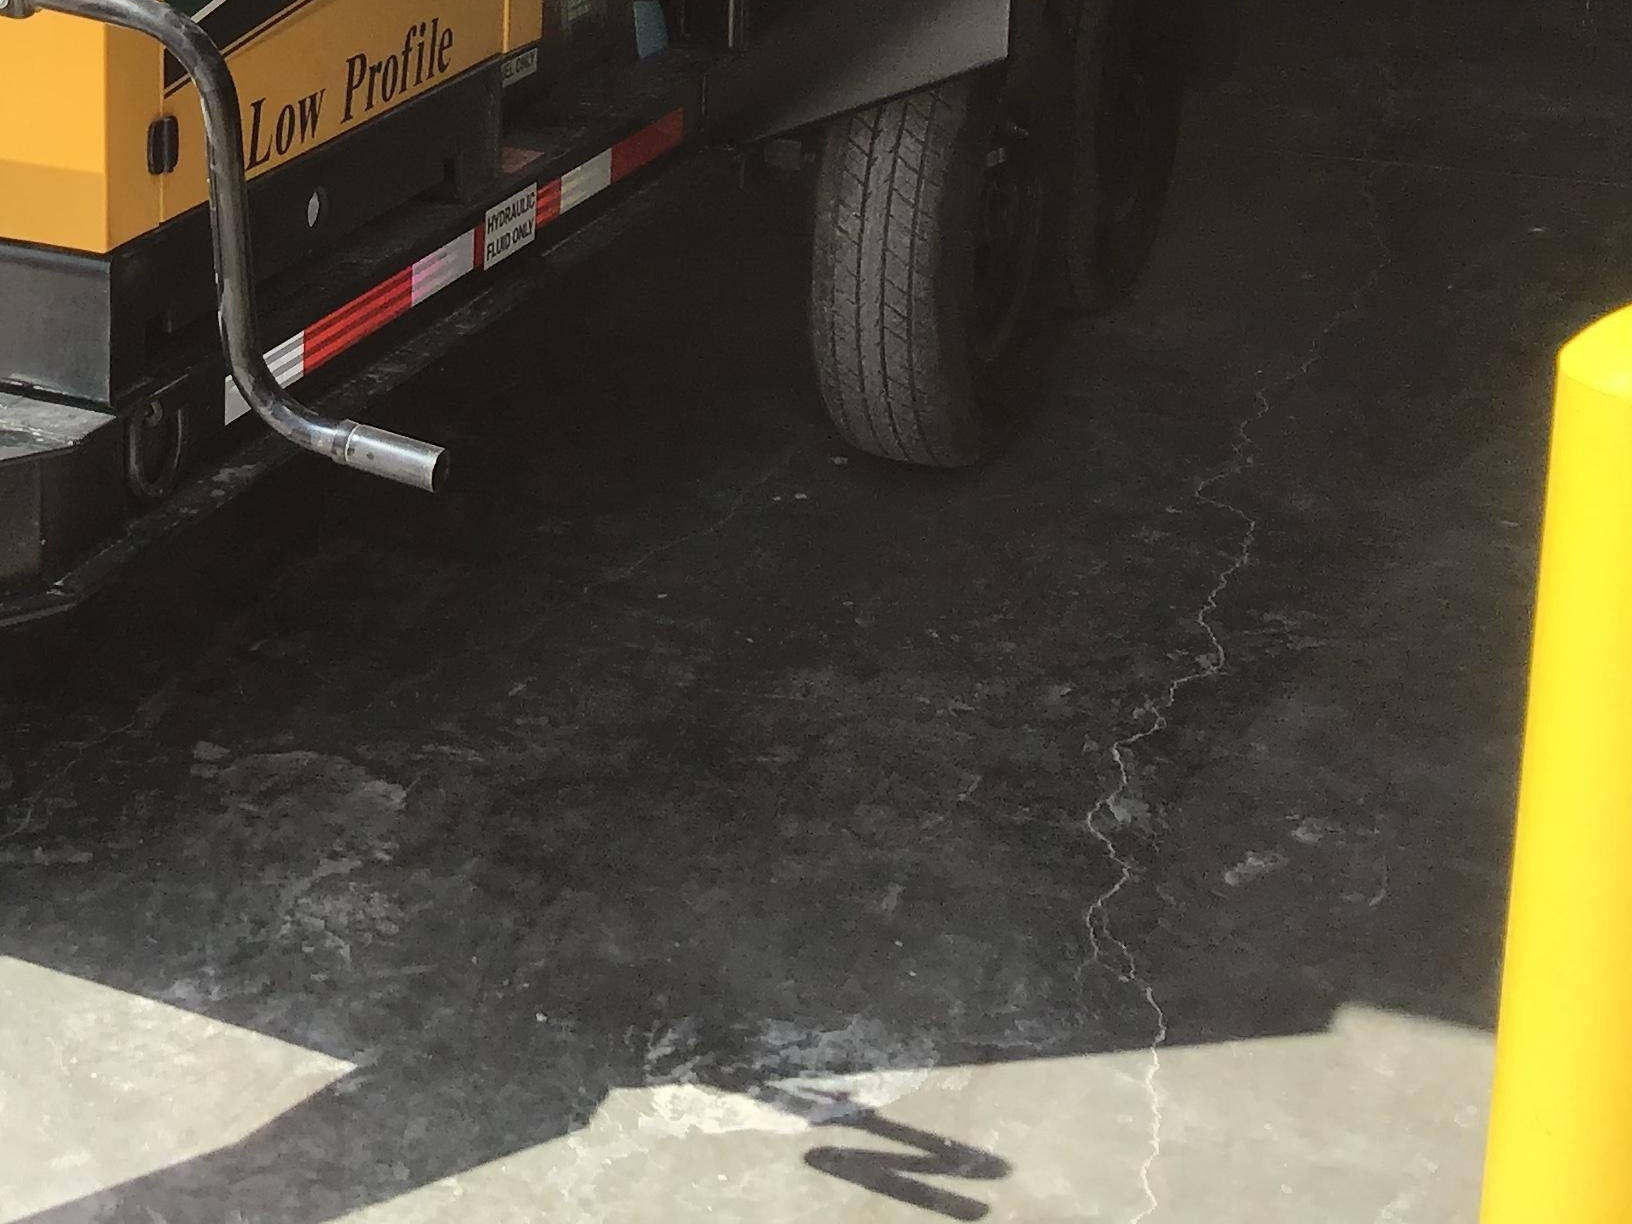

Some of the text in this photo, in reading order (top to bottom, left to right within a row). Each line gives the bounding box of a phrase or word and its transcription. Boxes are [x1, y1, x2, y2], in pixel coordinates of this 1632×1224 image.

[245, 17, 454, 171] Low Profile
[487, 191, 535, 234] HYDRAULIC
[486, 218, 534, 261] FLUID ONLY
